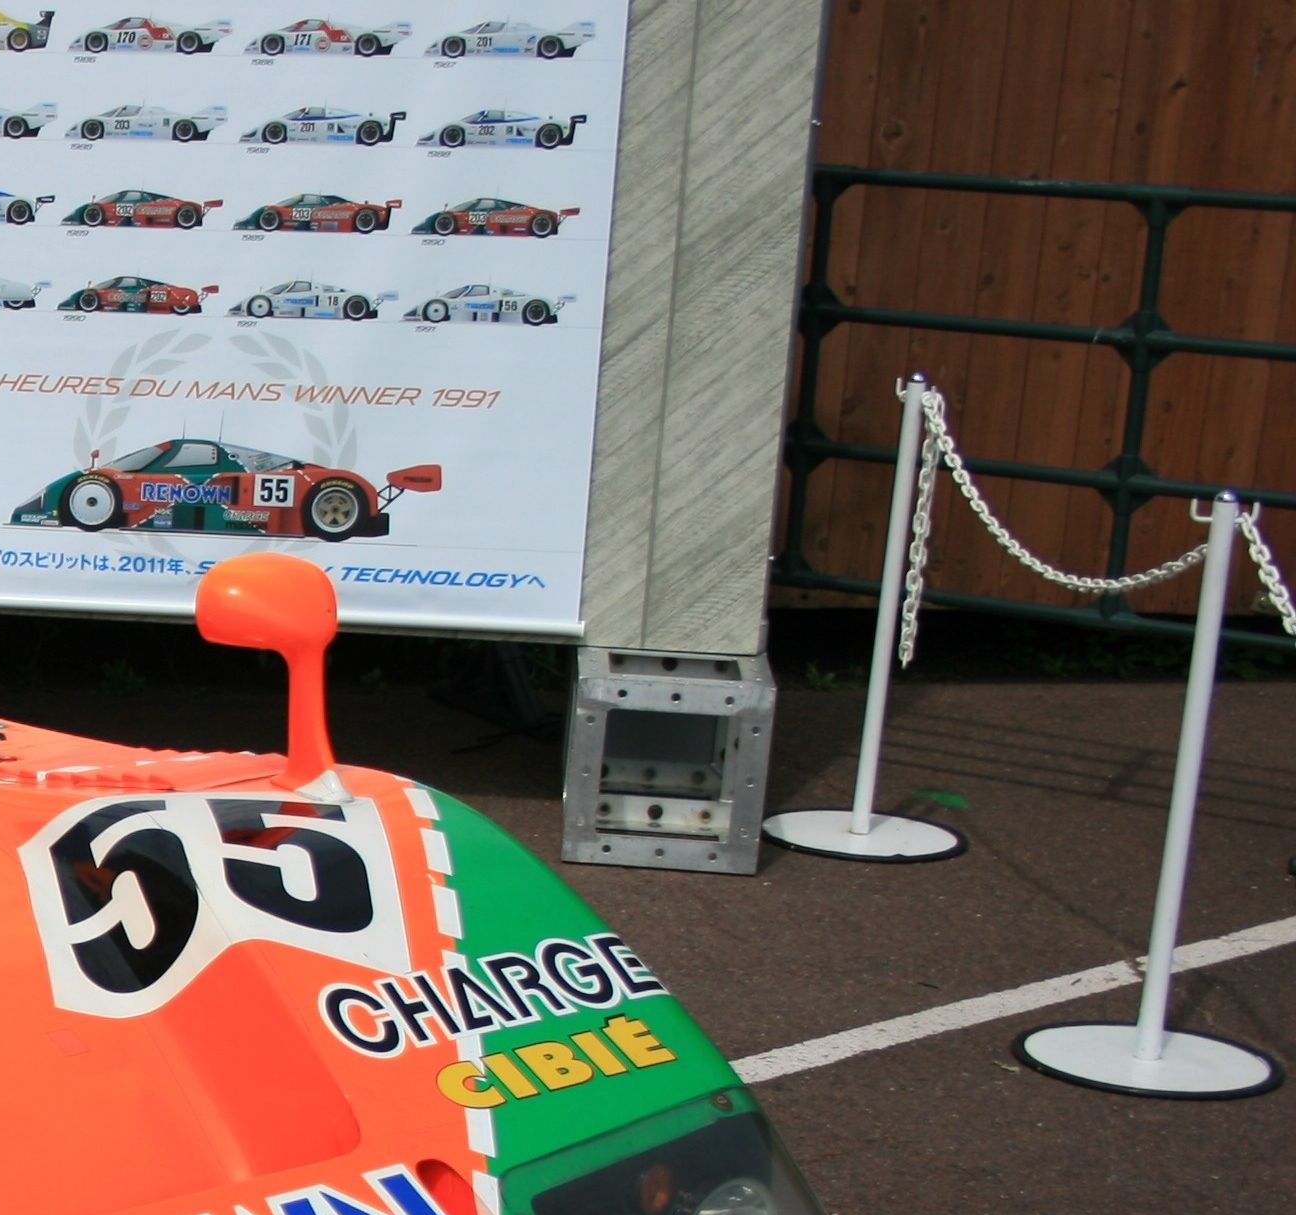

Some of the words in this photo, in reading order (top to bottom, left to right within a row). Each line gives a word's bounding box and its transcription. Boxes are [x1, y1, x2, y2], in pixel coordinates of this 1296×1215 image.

[116, 30, 136, 44] 170
[293, 33, 311, 46] 171
[476, 35, 492, 48] 201
[114, 119, 130, 130] 203
[300, 122, 315, 133] 201
[478, 125, 495, 136] 202
[327, 295, 339, 307] 18
[504, 300, 518, 312] 56
[129, 378, 182, 399] DU
[185, 380, 287, 402] MANS
[293, 384, 423, 407] WINNER
[431, 387, 502, 409] 1991
[140, 482, 232, 505] RENOWN
[259, 478, 289, 503] 55
[48, 799, 374, 994] 55
[318, 934, 671, 1057] CHARGE
[437, 1013, 677, 1110] CIBIÉ
